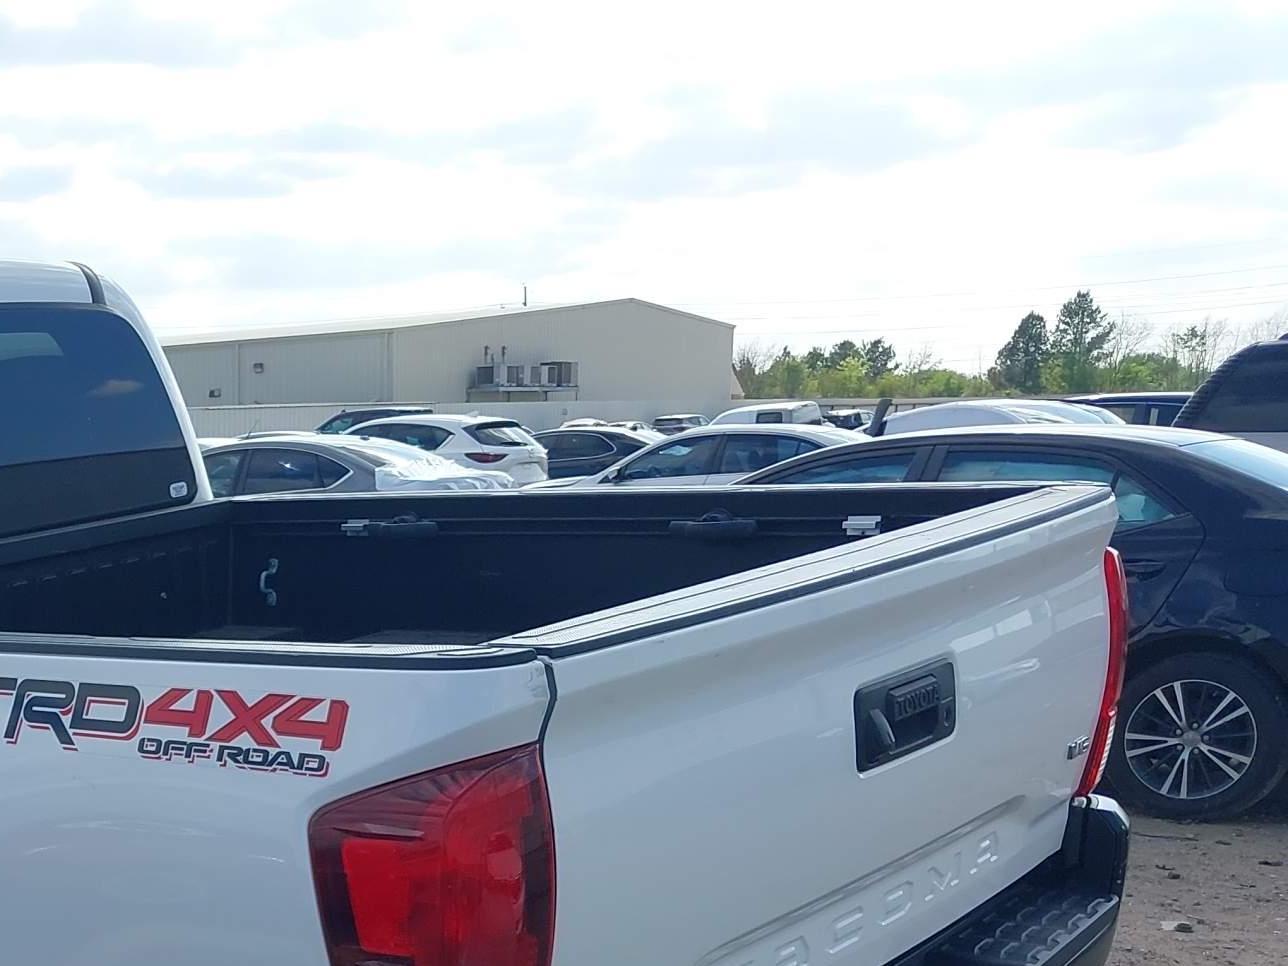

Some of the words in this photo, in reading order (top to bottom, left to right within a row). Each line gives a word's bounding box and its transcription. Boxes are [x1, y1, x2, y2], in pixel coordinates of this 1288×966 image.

[895, 684, 940, 717] TOYOTA
[137, 736, 216, 764] OFF
[215, 744, 331, 778] ROAD
